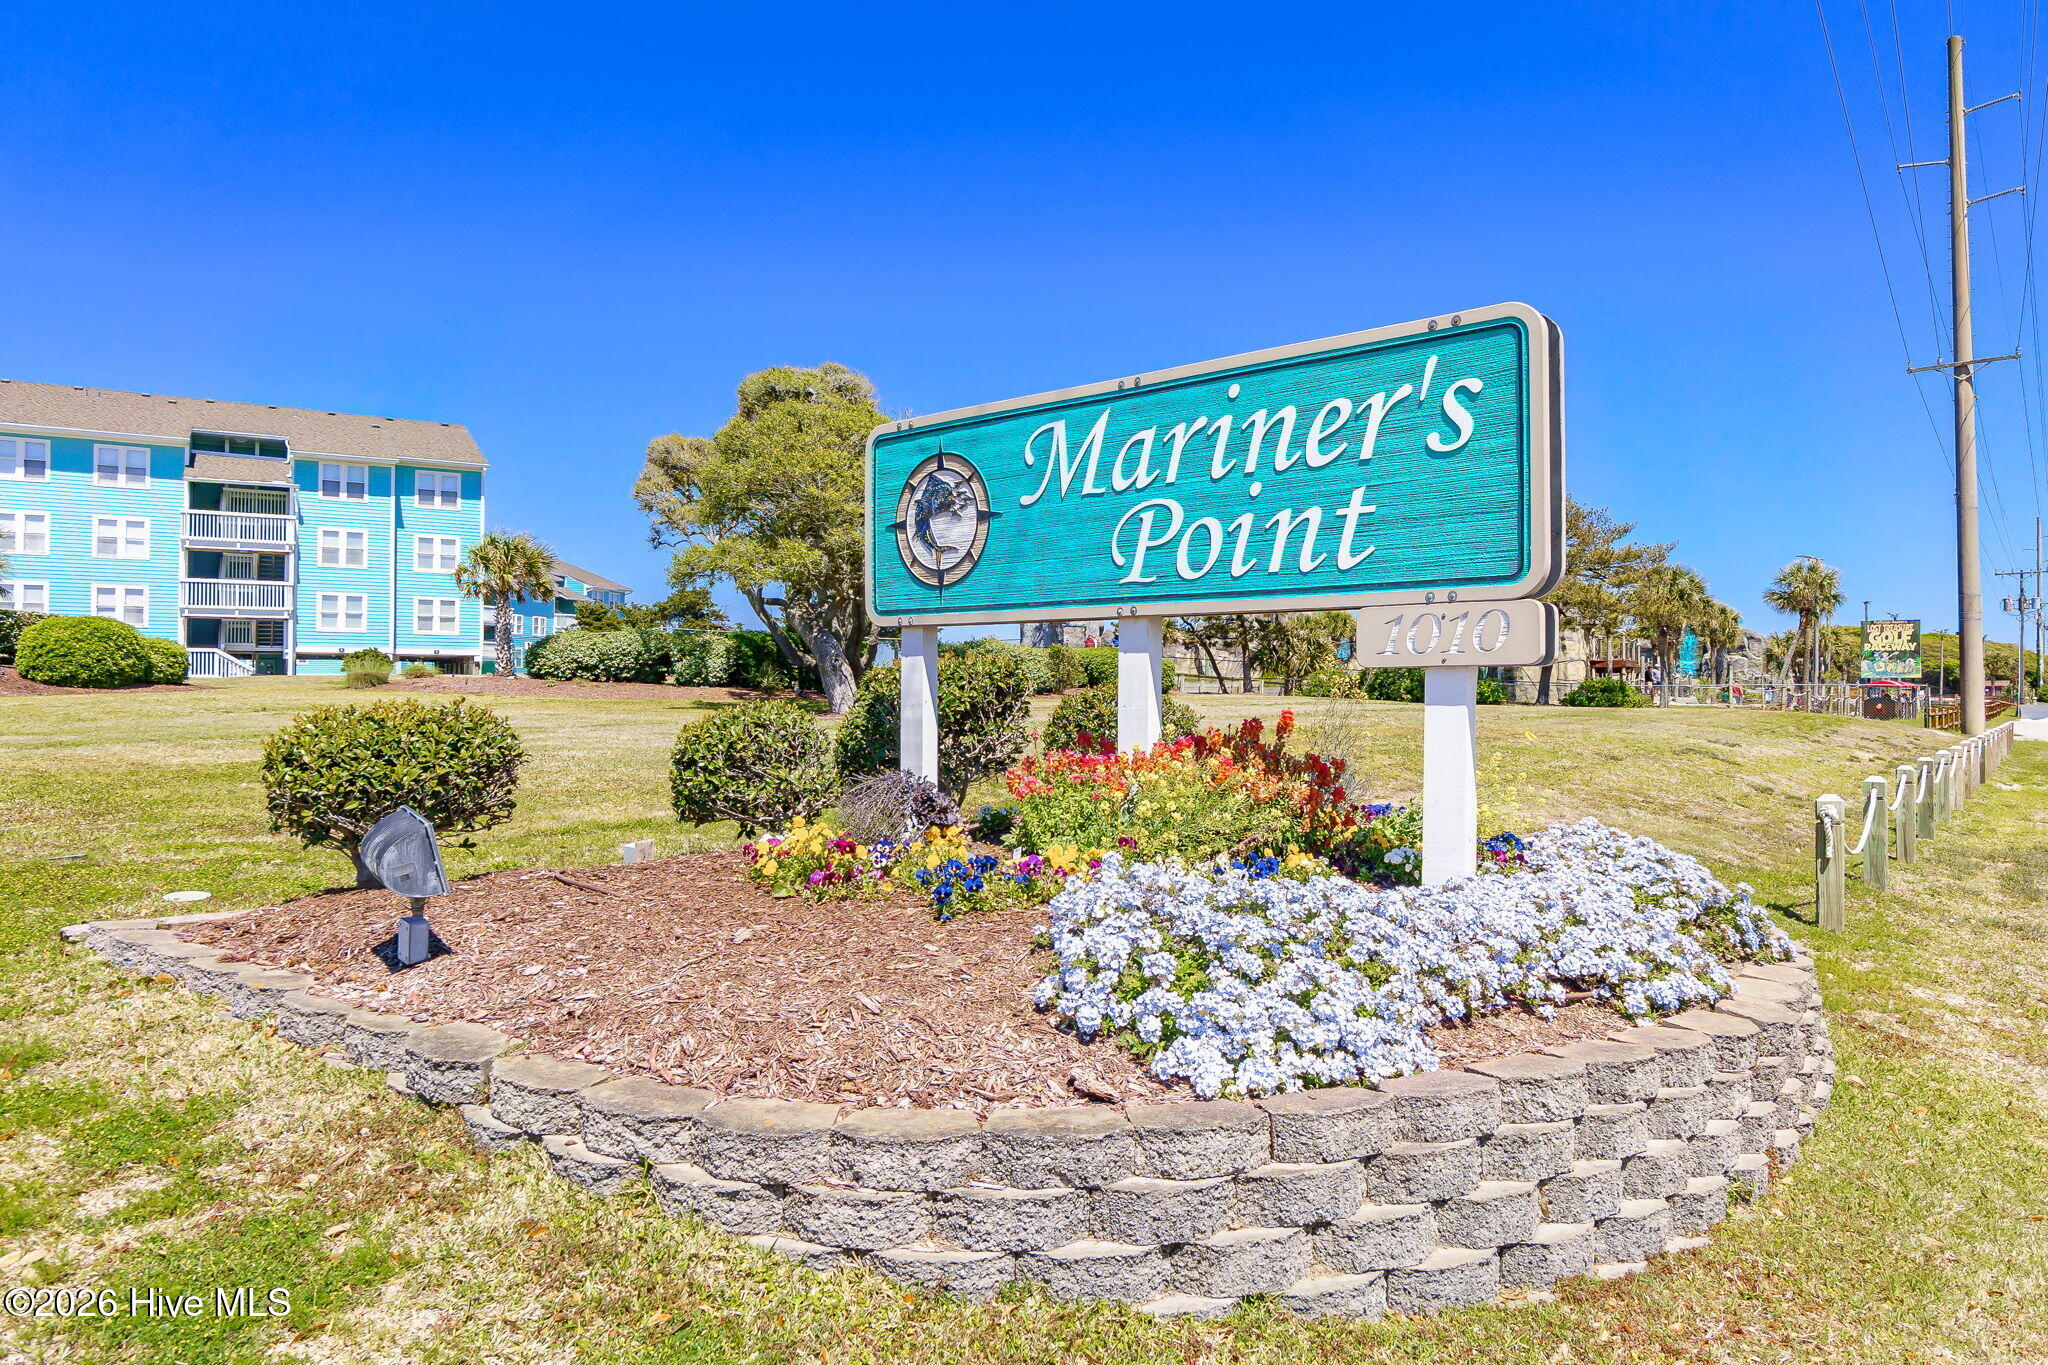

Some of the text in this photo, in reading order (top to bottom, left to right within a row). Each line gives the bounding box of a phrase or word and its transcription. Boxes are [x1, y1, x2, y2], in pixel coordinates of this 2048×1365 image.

[1018, 354, 1484, 507] Mariner's
[1111, 481, 1377, 584] Point
[1376, 608, 1510, 655] 1010
[1868, 630, 1913, 645] GOLF
[1883, 623, 1915, 631] TREASURE
[1864, 642, 1917, 651] RACEWAY
